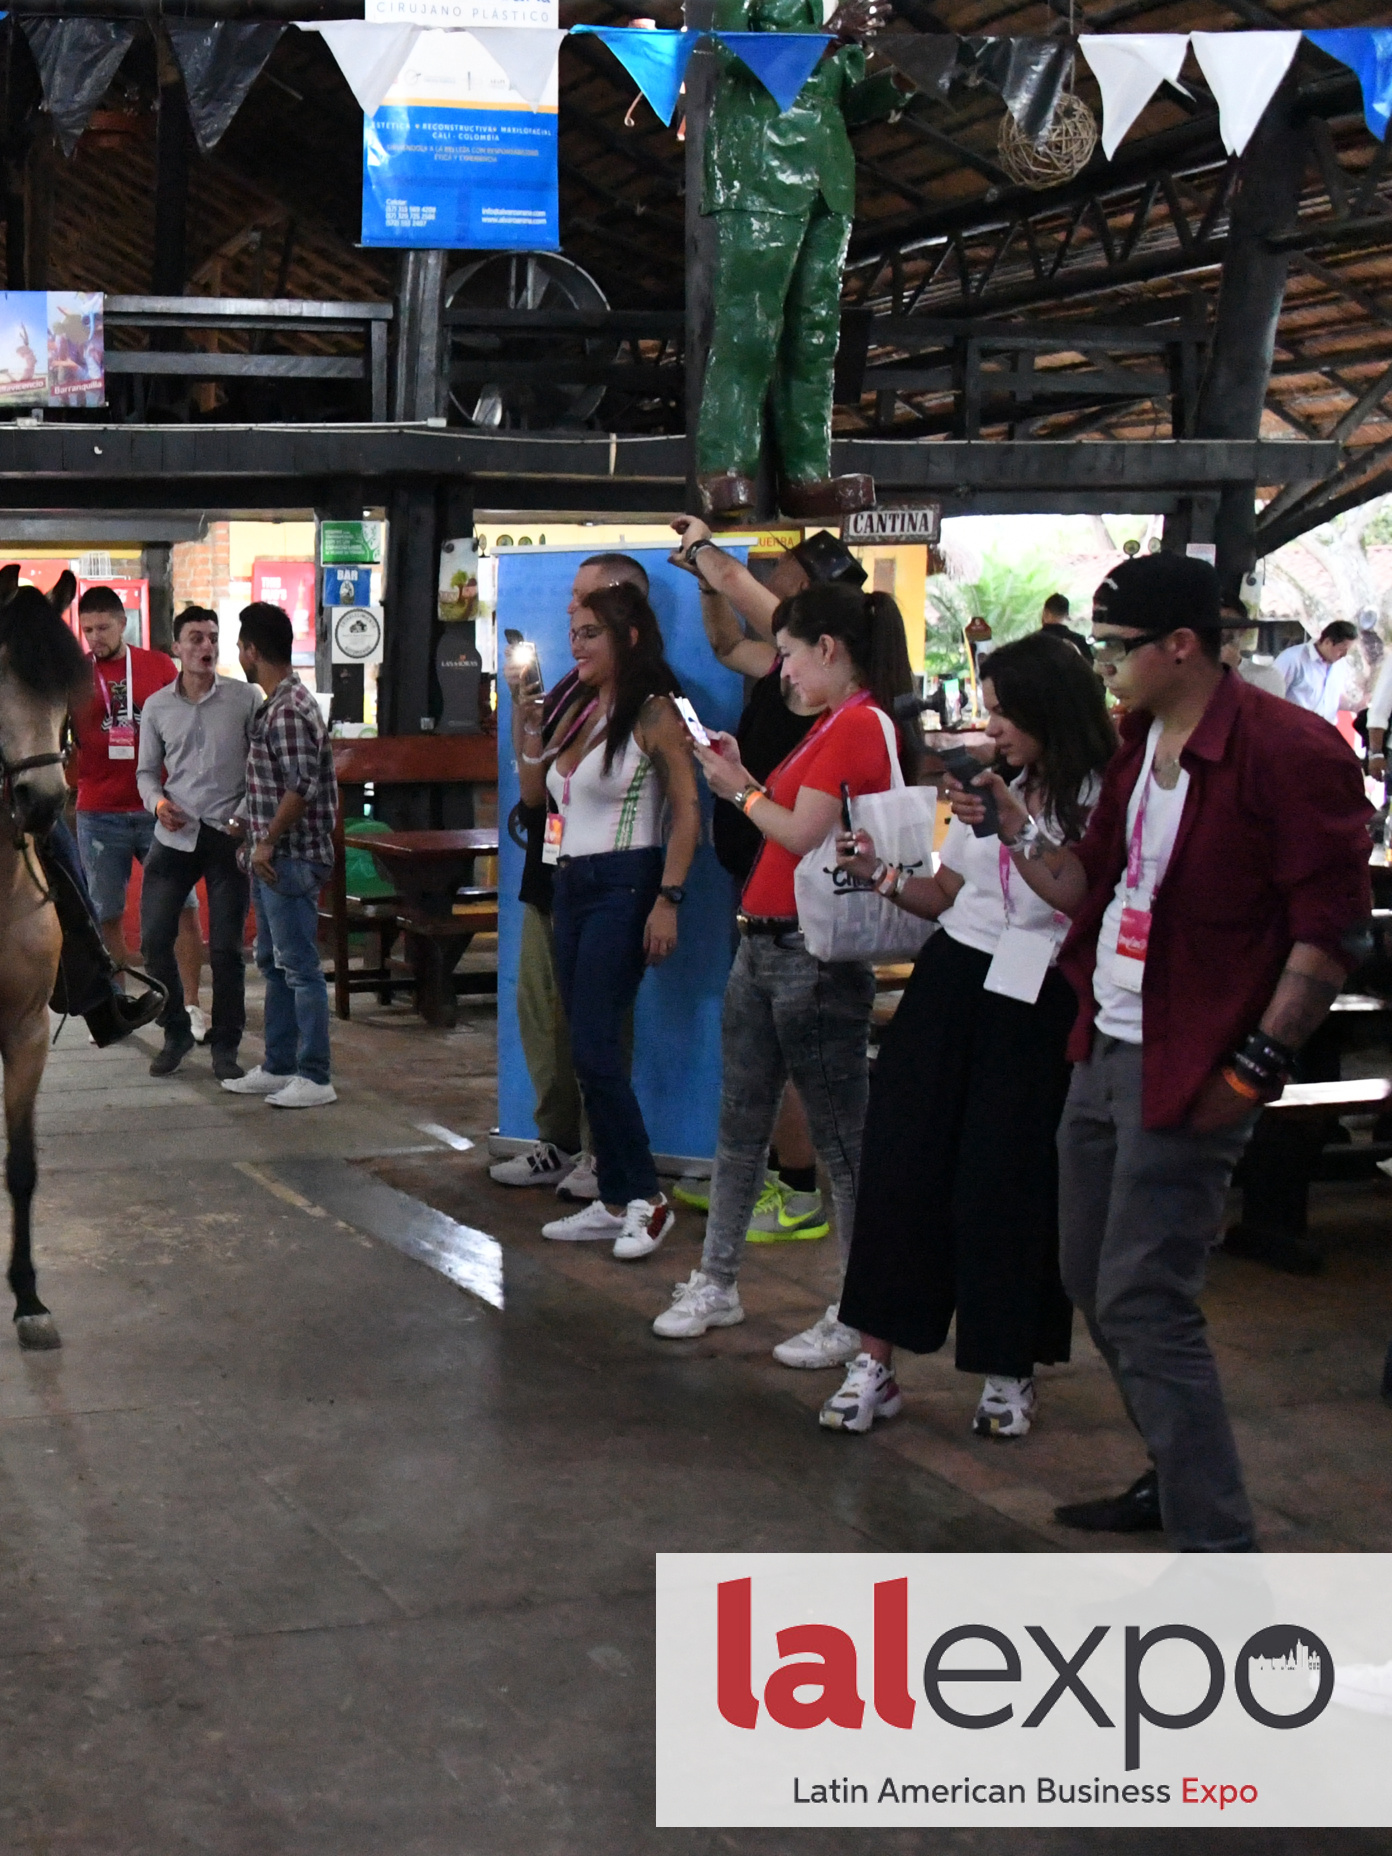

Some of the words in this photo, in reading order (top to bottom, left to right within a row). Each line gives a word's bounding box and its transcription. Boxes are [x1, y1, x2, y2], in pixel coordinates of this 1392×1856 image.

[376, 2, 462, 17] CIRUJANO
[432, 132, 451, 140] CALI
[458, 133, 500, 142] COLOMBIA
[54, 380, 103, 395] Barranquilla
[853, 512, 929, 534] CANTINA
[758, 537, 795, 548] UERRA
[337, 569, 358, 581] BAR
